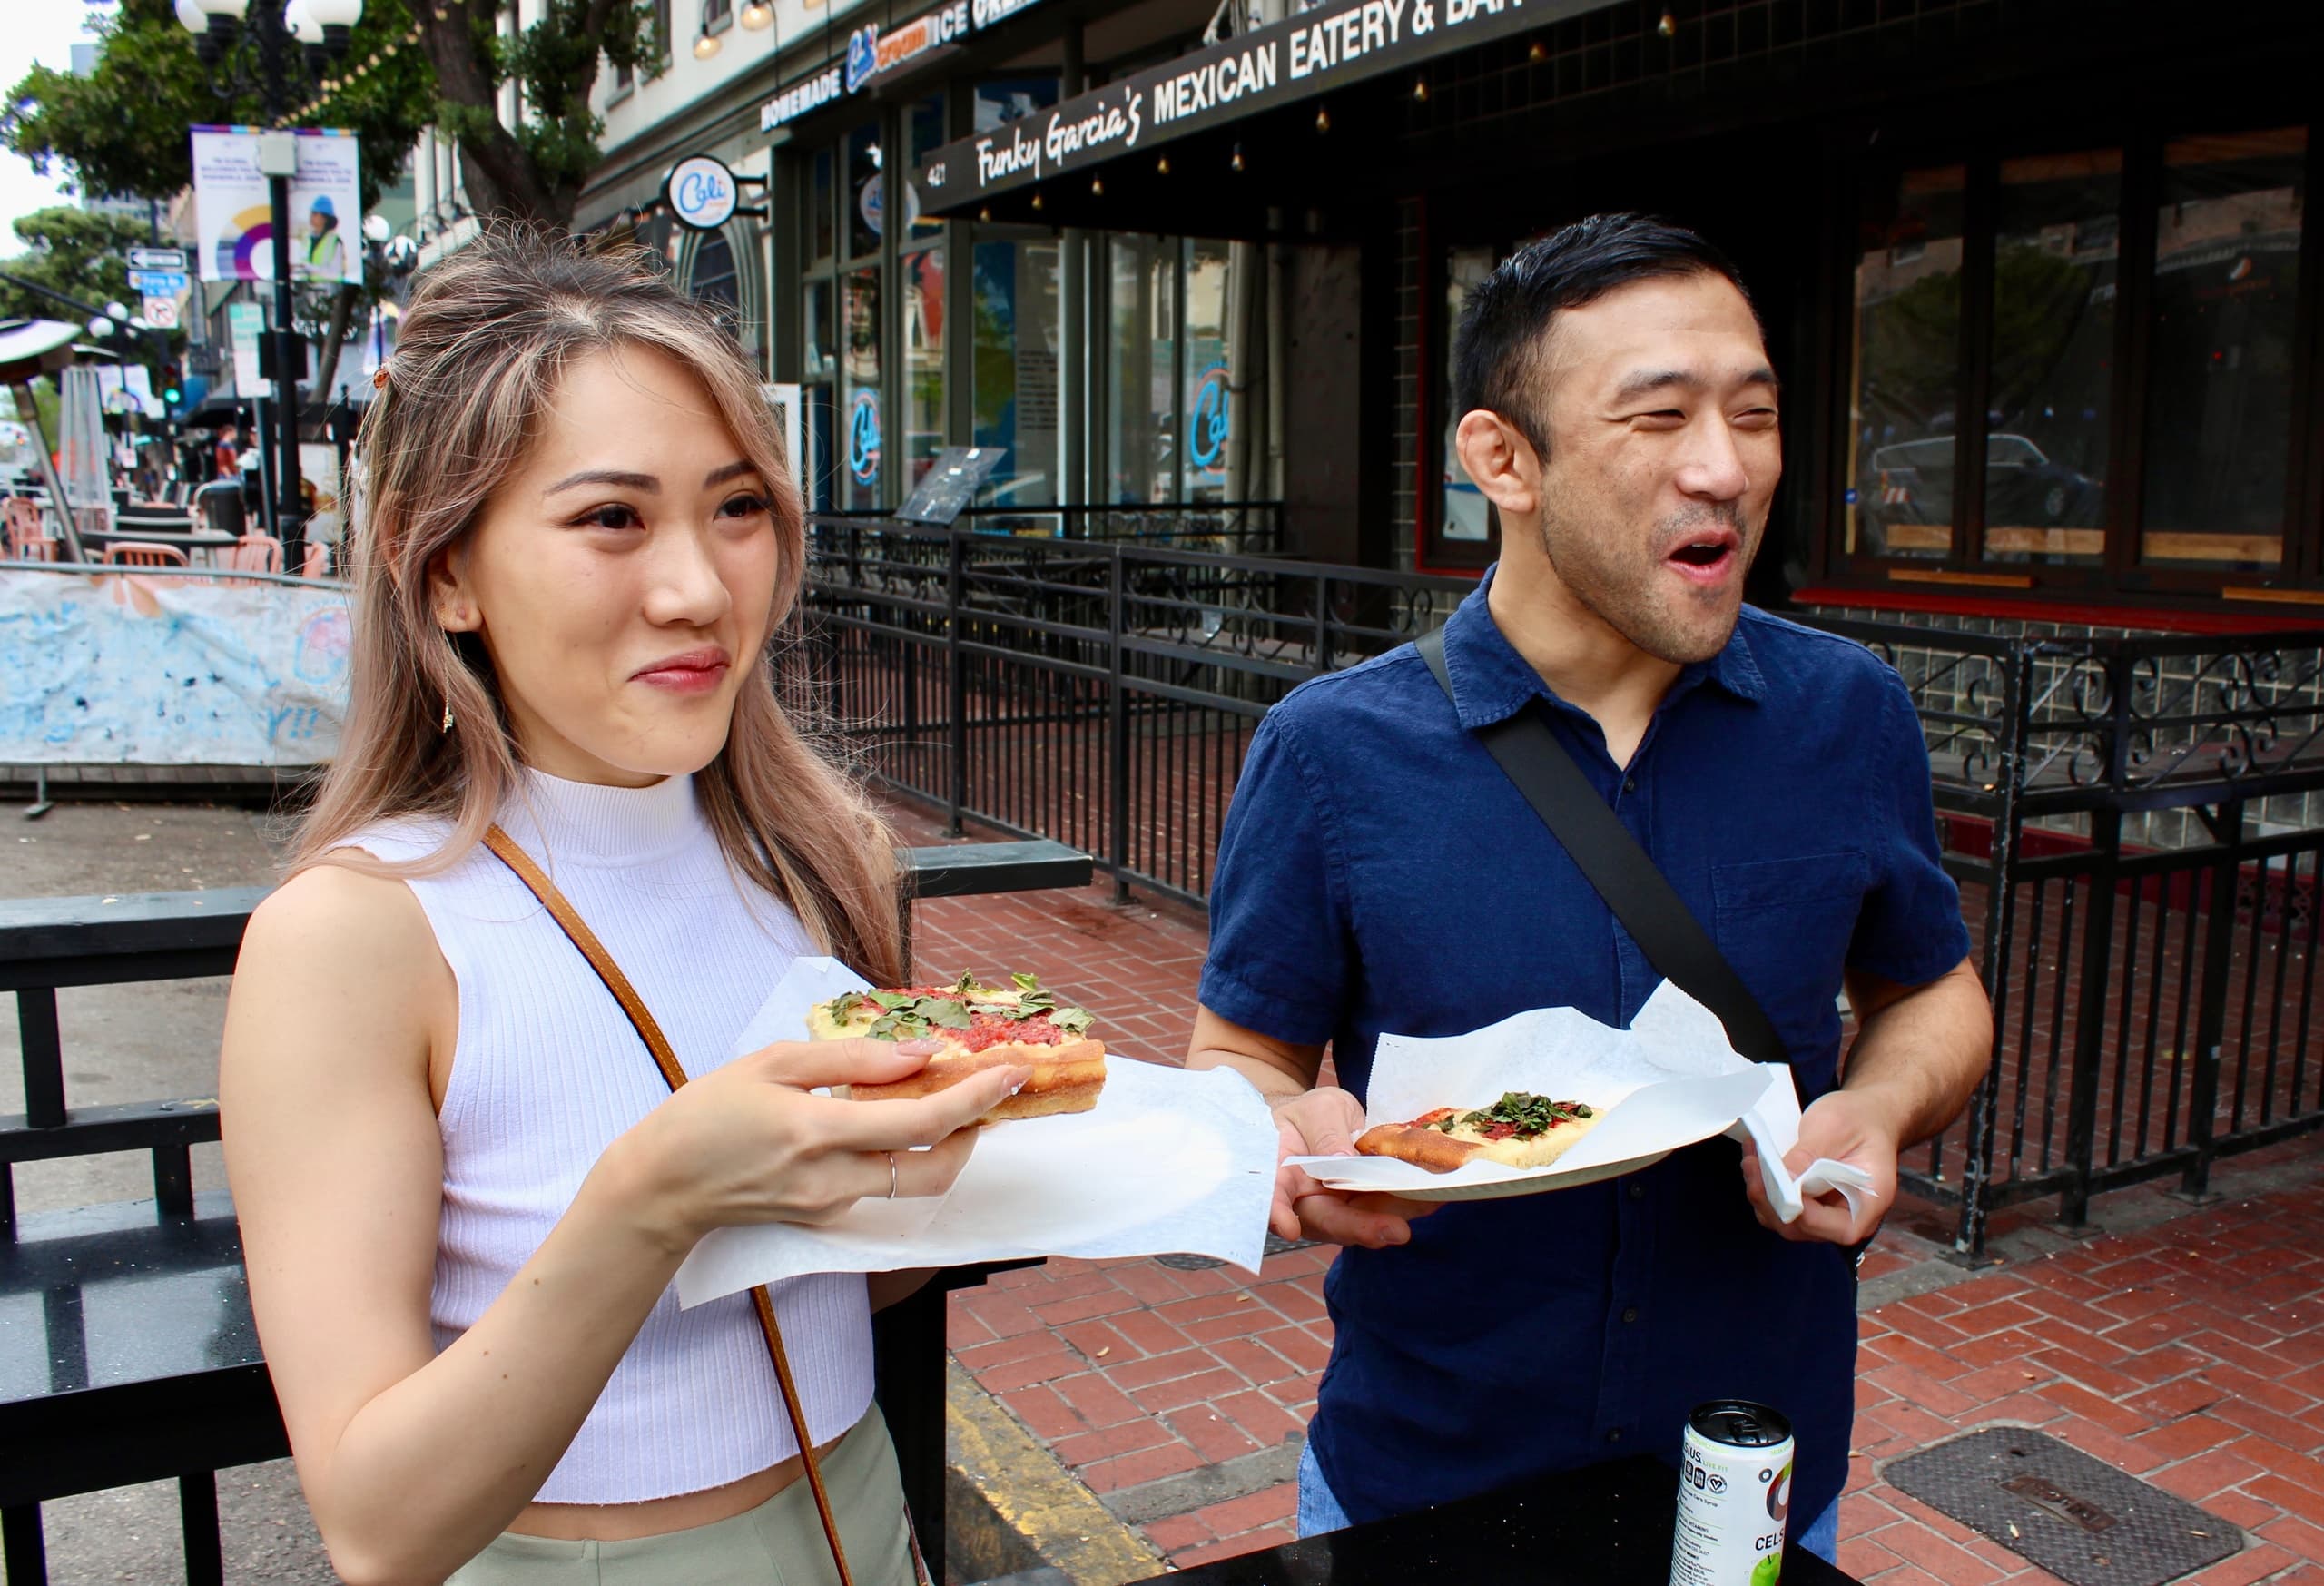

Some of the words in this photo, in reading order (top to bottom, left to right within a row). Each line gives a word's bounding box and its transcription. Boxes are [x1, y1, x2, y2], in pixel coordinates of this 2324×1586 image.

[760, 68, 842, 132] HOMEMADE
[932, 2, 969, 46] ICE
[976, 127, 1041, 187] Funky
[1046, 85, 1143, 167] Garcia's
[1153, 41, 1277, 125] MEXICAN
[1289, 0, 1404, 80] EATERY
[679, 172, 726, 213] Cali
